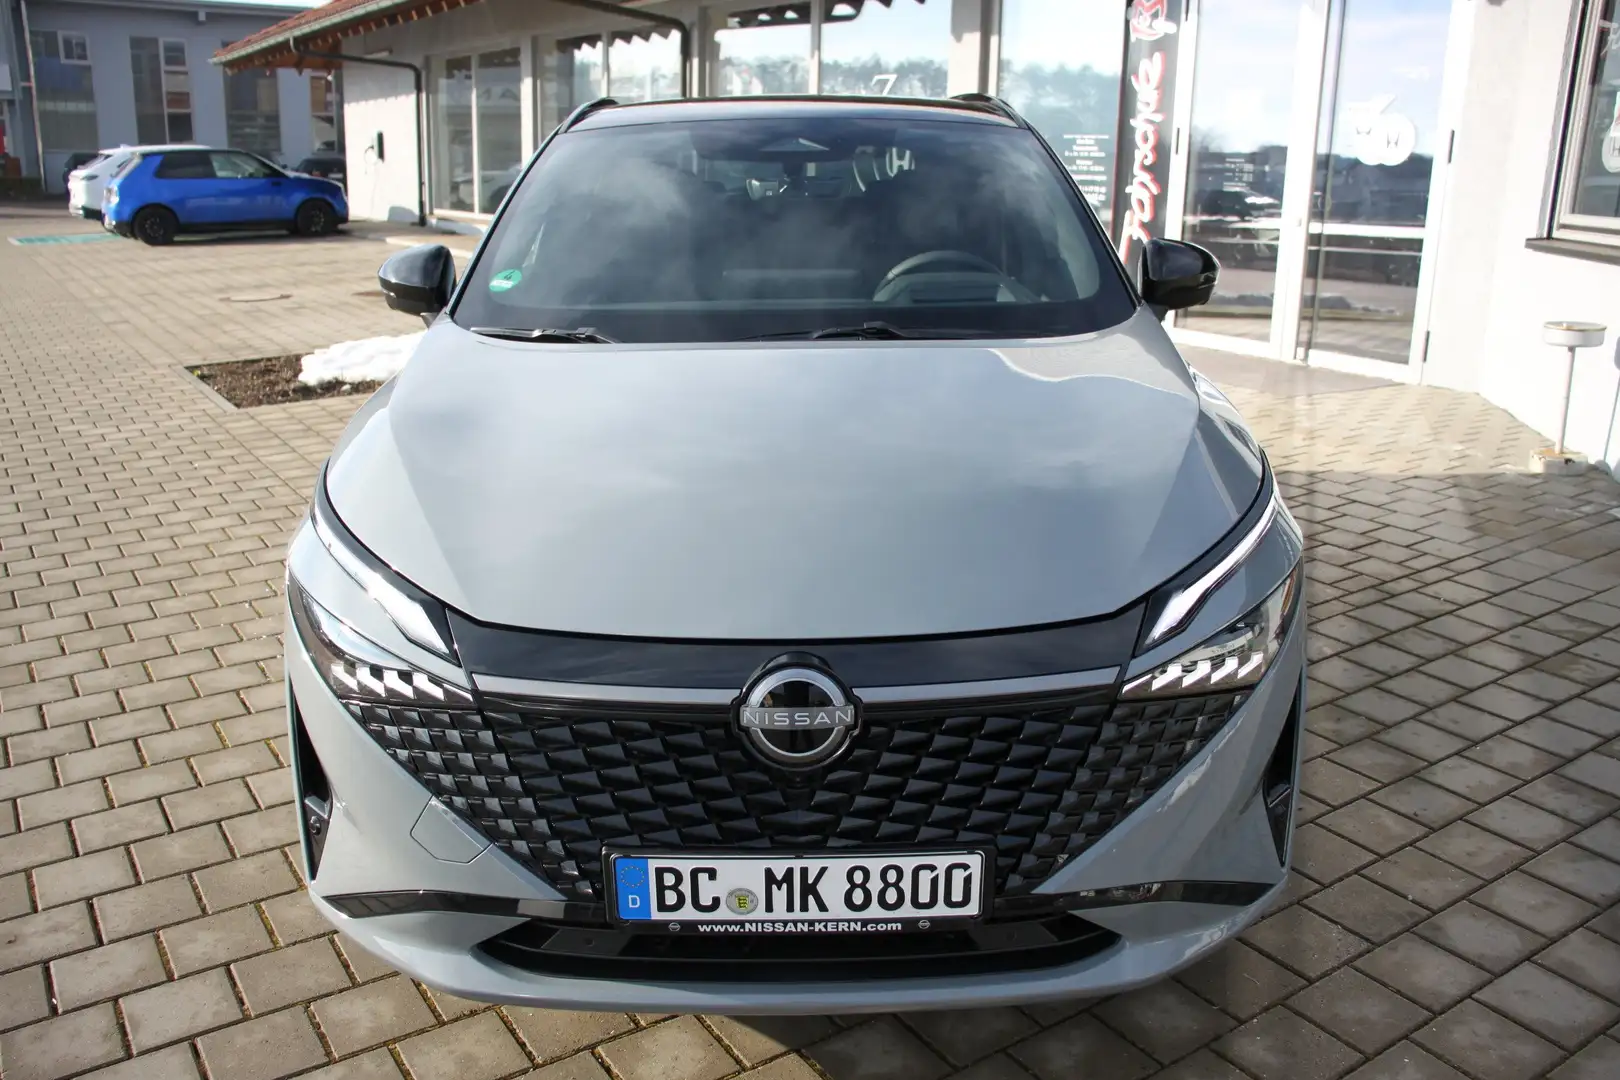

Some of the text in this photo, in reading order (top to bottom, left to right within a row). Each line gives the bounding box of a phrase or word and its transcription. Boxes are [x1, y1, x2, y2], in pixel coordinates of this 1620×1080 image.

[743, 709, 852, 725] NISSAN
[628, 894, 641, 908] D
[654, 866, 721, 913] BC
[764, 866, 829, 913] MK
[843, 862, 973, 913] 8800
[697, 921, 902, 932] www.NISSAN-KERN.com
